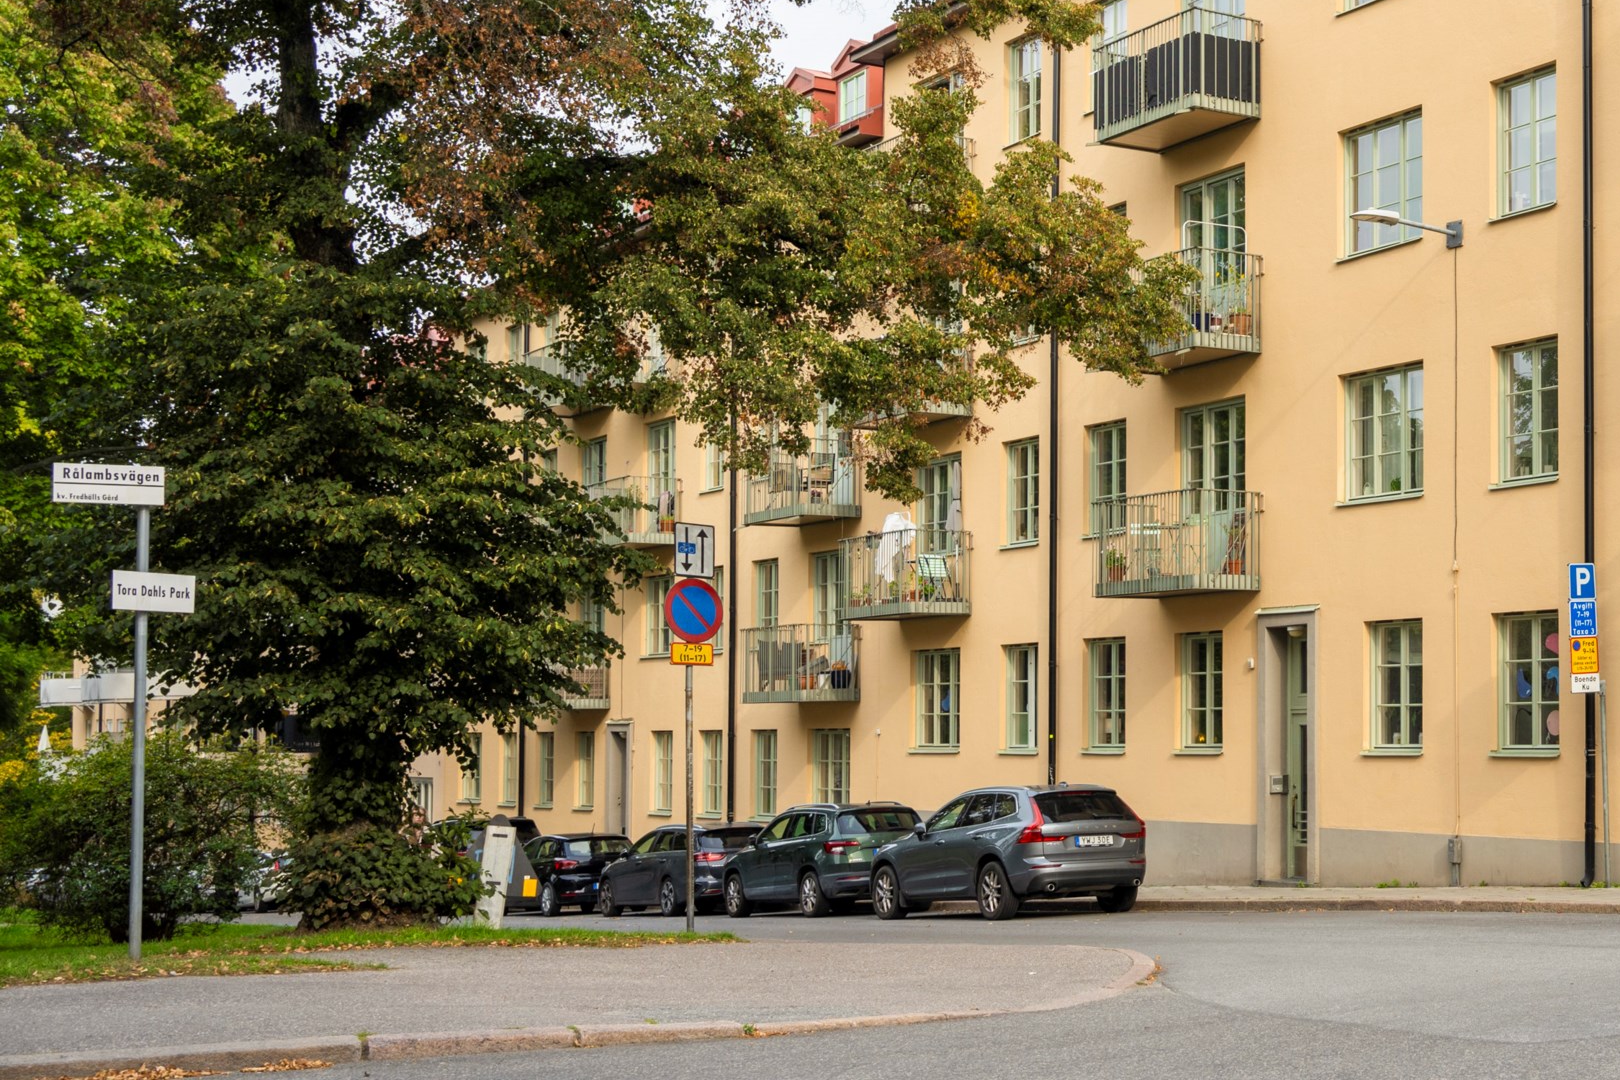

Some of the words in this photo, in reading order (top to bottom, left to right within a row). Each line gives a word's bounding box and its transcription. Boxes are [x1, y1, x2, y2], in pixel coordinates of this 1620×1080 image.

[63, 467, 160, 485] Rålambsvägen
[56, 492, 68, 500] kv.
[69, 492, 101, 501] Fredhälls
[102, 493, 119, 502] Gård
[1576, 567, 1590, 596] P
[117, 583, 137, 597] Tora
[141, 584, 166, 598] Dahls
[169, 586, 190, 599] Park
[1573, 602, 1593, 611] Avgift
[1591, 627, 1595, 635] 3
[683, 644, 703, 652] 7-19
[679, 654, 707, 663] (11-17)
[1574, 675, 1597, 683] Boende
